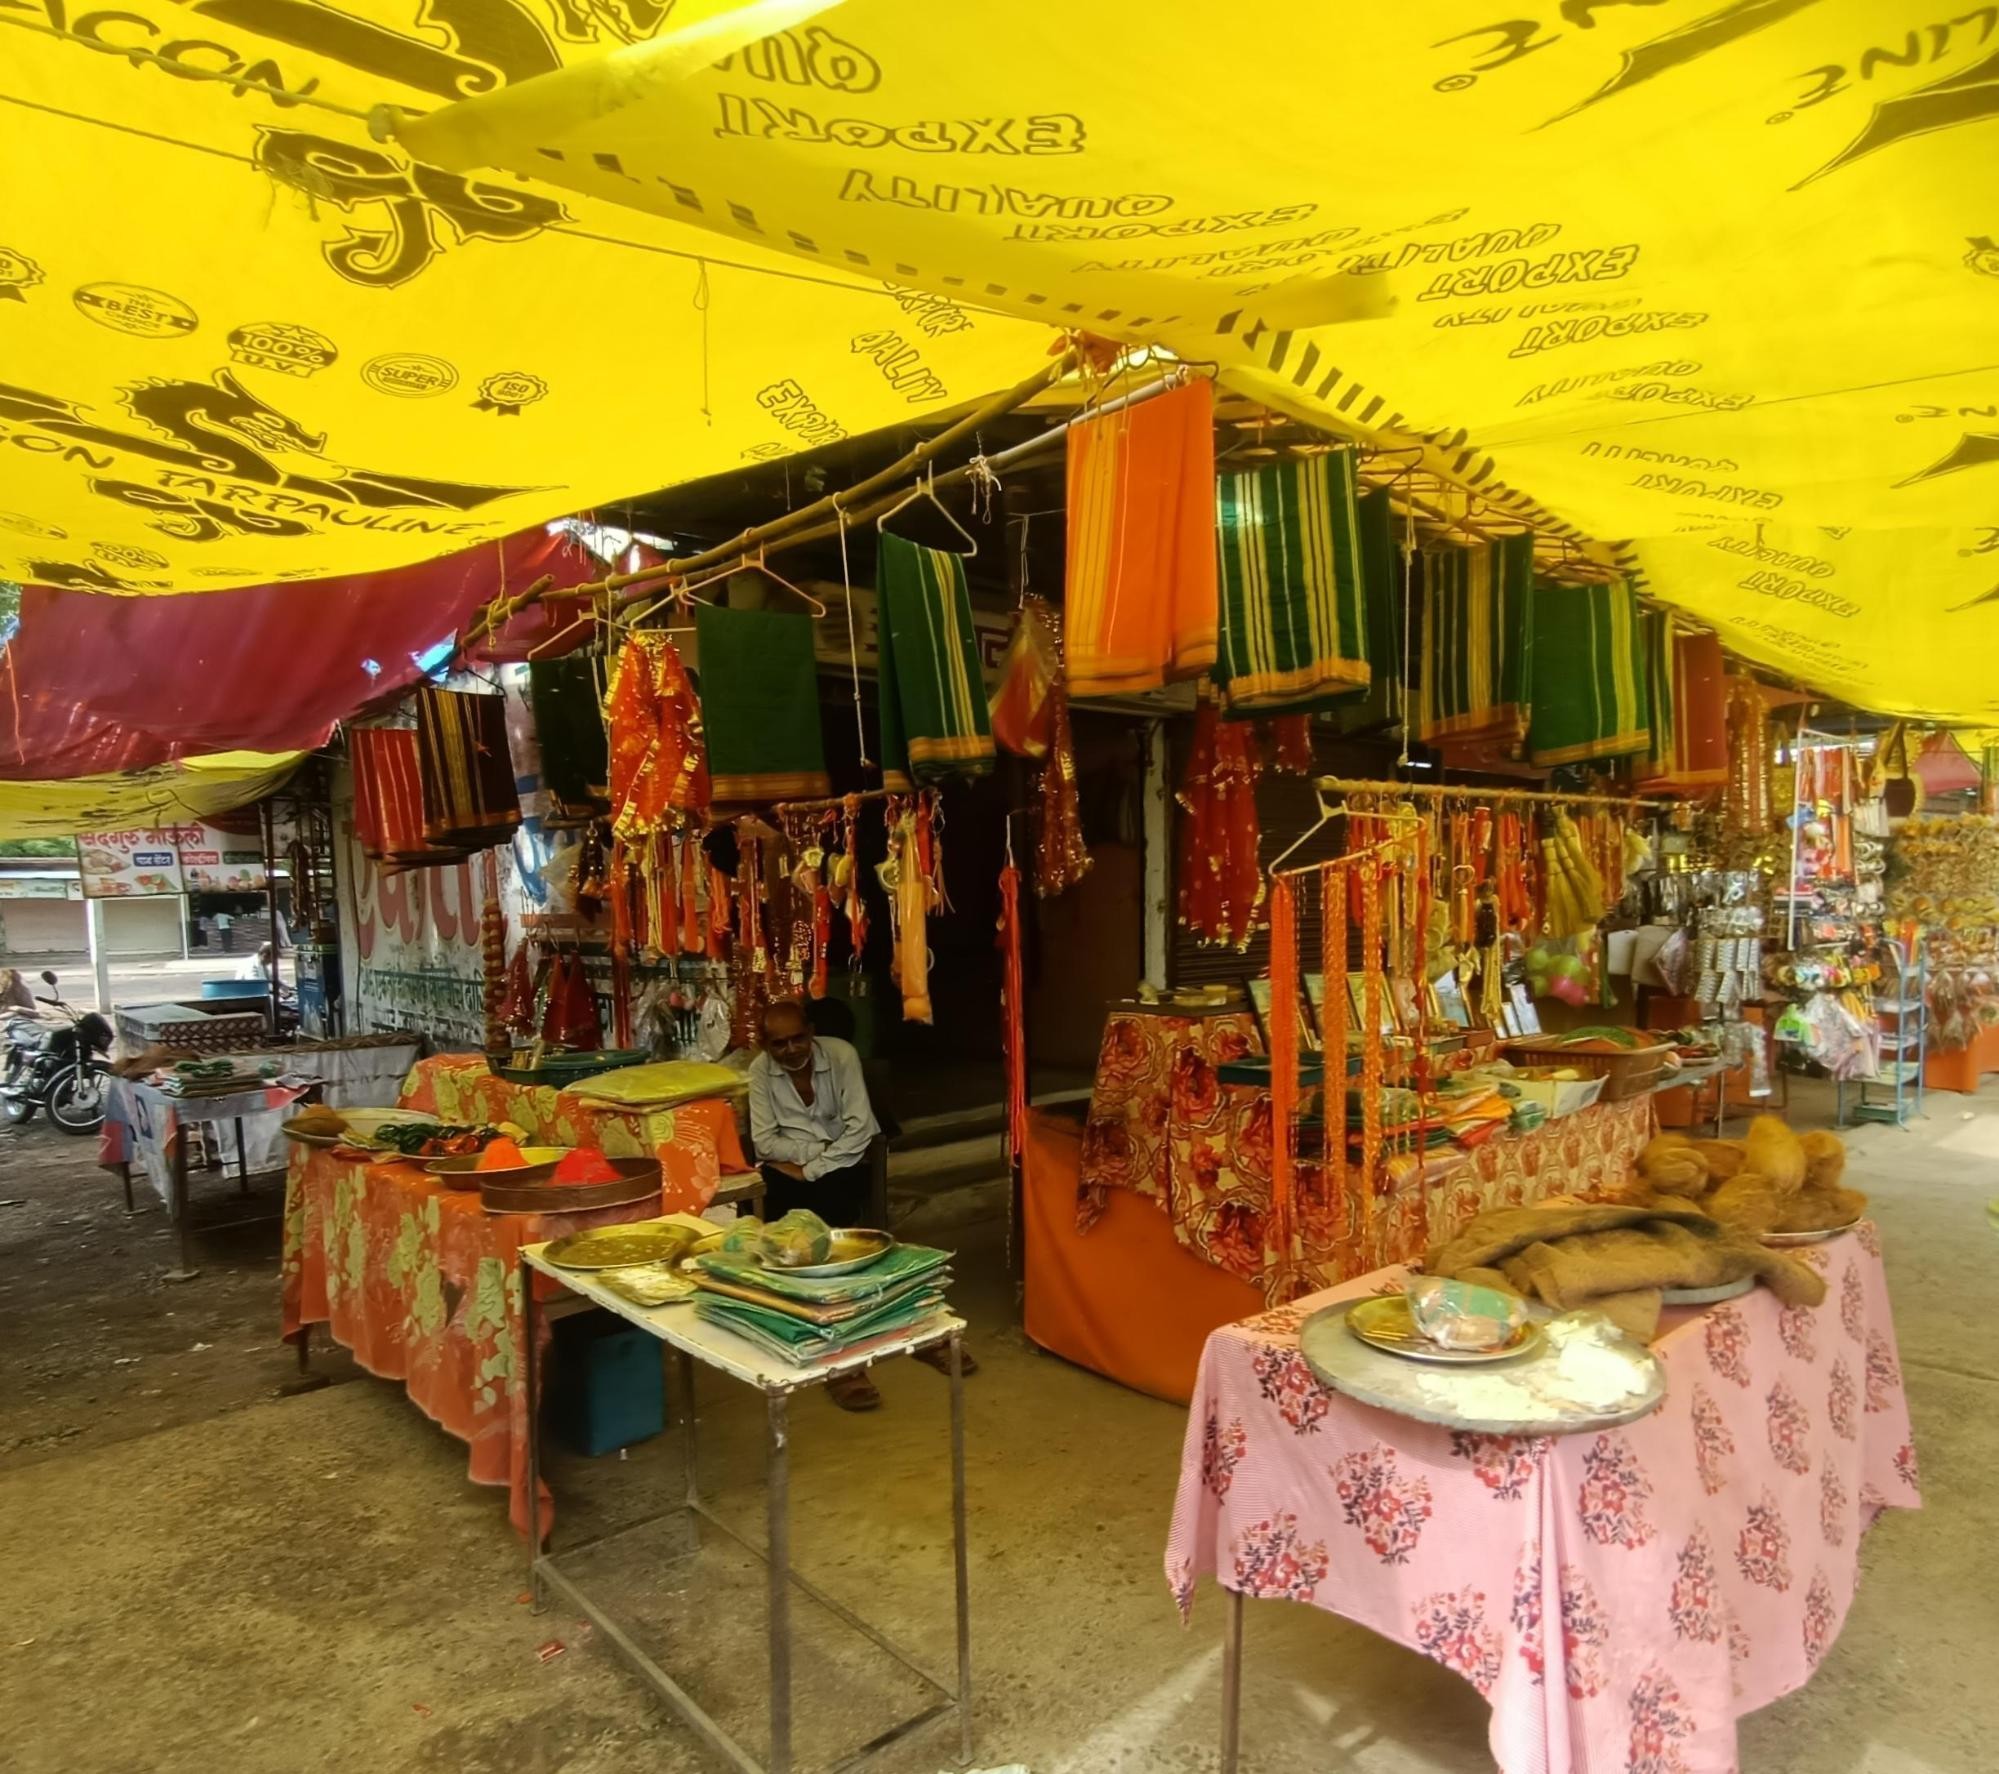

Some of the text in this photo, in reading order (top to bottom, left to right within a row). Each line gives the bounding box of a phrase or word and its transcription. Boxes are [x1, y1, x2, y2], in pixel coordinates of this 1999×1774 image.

[714, 92, 1087, 155] EXPORT
[838, 169, 1175, 220] QUALITY
[1003, 203, 1318, 243] EXPORT
[1417, 243, 1641, 303] EXPORT
[105, 310, 161, 329] CHOICE
[106, 300, 169, 323] BEST
[129, 298, 155, 310] THE
[242, 333, 325, 363] 100%
[1507, 310, 1711, 359] EXPORT
[381, 367, 440, 386] SUPER
[504, 381, 530, 393] ISO
[156, 469, 486, 535] TARPAULINE
[1738, 571, 1861, 618] EXPORT
